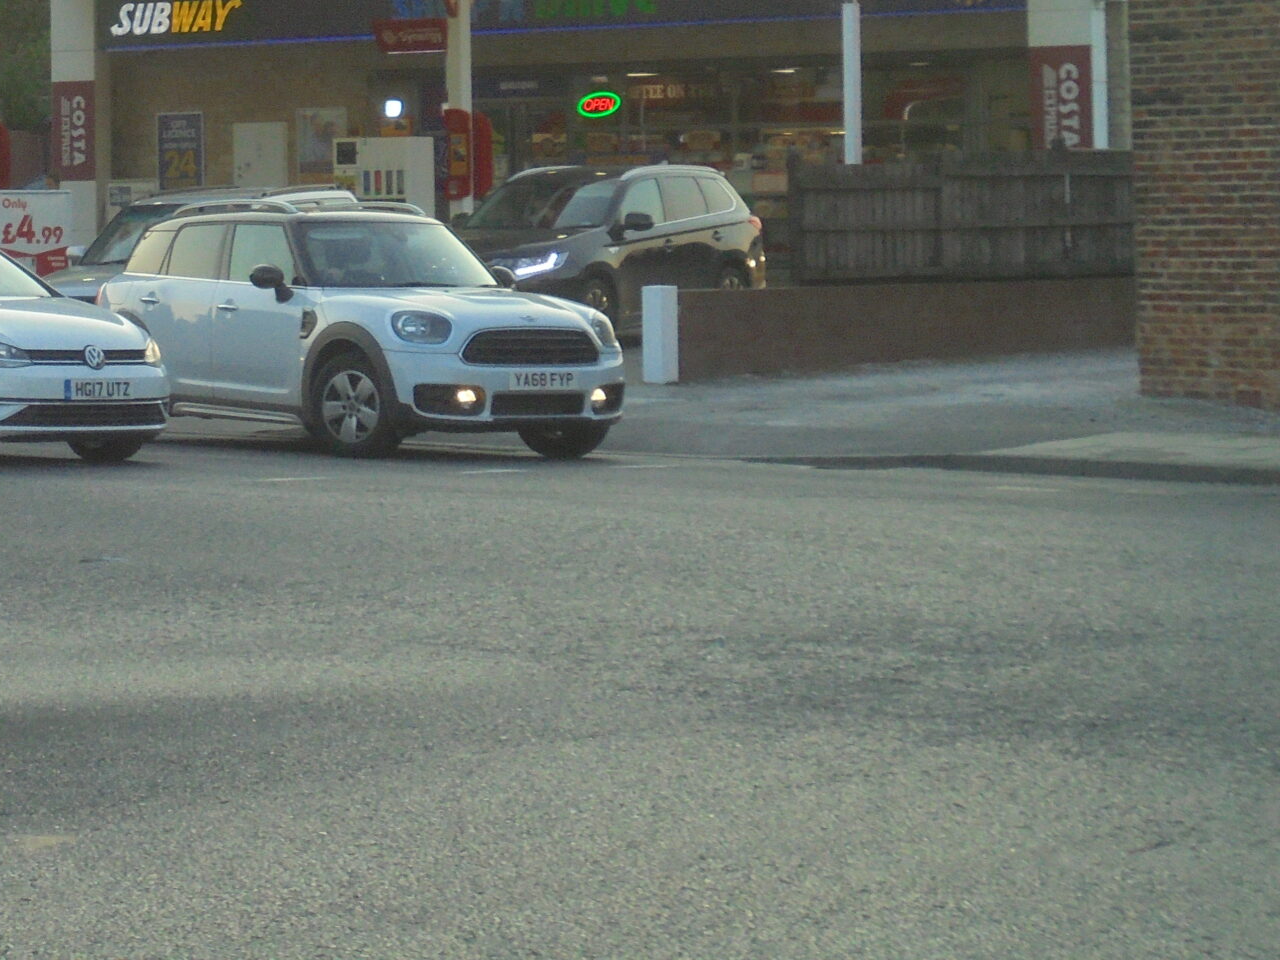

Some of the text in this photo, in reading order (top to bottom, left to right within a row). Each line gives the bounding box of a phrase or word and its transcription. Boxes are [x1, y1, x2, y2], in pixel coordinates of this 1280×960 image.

[583, 98, 615, 112] OPEN
[1059, 62, 1081, 147] COSTA
[72, 95, 86, 166] COSTA
[164, 151, 196, 177] 24
[2, 198, 27, 211] Only
[1, 214, 64, 244] £4.99
[75, 382, 131, 396] HG17 UTZ
[514, 373, 574, 386] YA68 FYP
